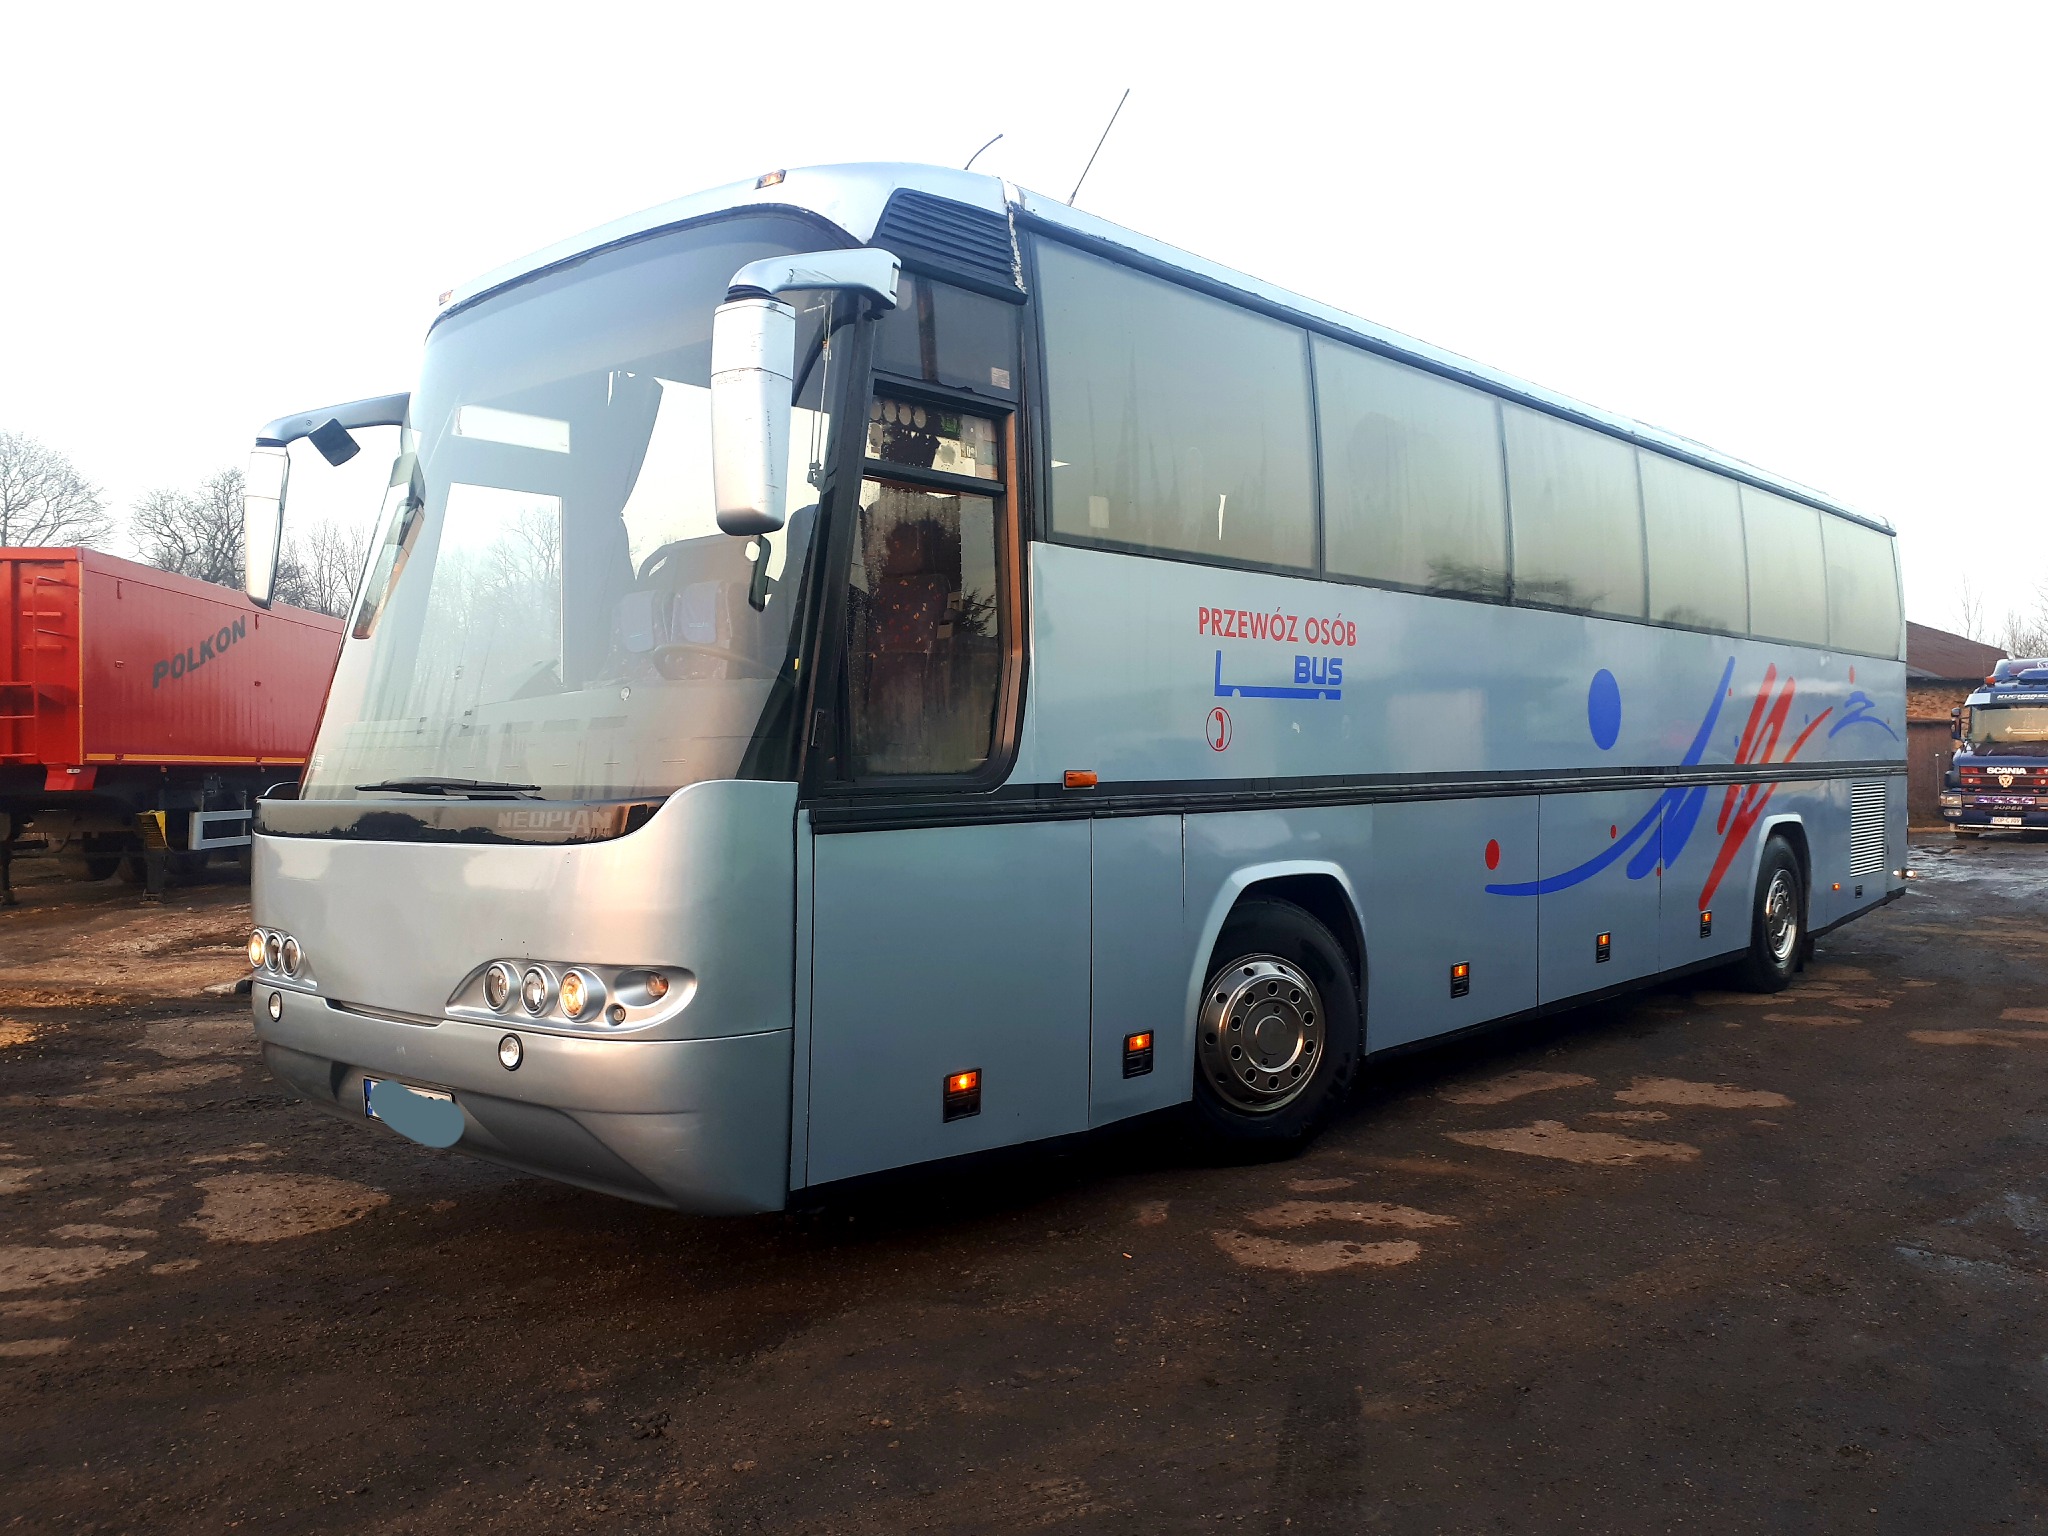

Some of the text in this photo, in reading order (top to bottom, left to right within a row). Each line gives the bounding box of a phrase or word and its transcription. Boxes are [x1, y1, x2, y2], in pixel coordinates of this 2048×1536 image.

[1198, 607, 1357, 647] PRZEWÓZ OSÓB
[152, 615, 247, 689] POLKON
[1294, 655, 1343, 686] BUS
[1986, 766, 2027, 775] SCANIA
[497, 809, 614, 834] NEOPLAN
